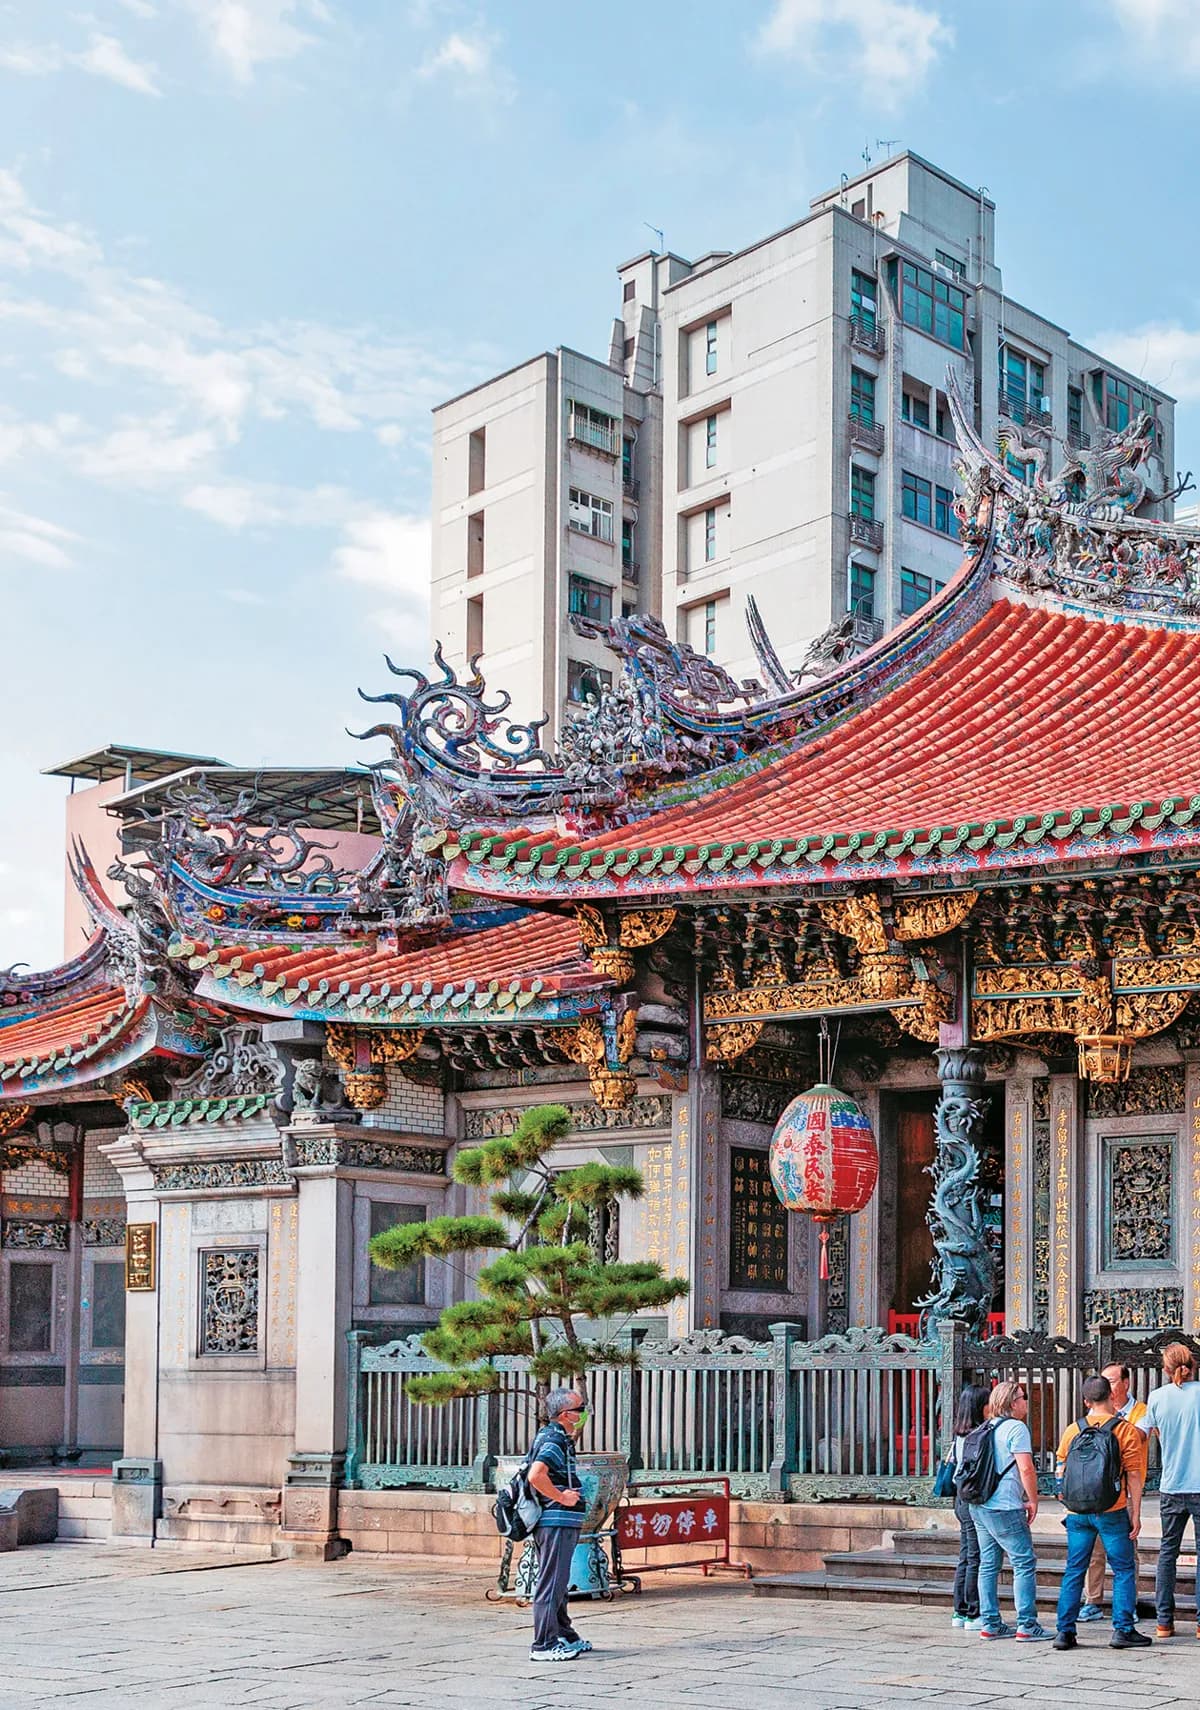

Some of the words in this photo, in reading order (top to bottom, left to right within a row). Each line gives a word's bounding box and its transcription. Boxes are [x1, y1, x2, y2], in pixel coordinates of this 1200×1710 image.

[803, 1111, 827, 1202] 國泰民安
[625, 1508, 718, 1539] 請勿停車
